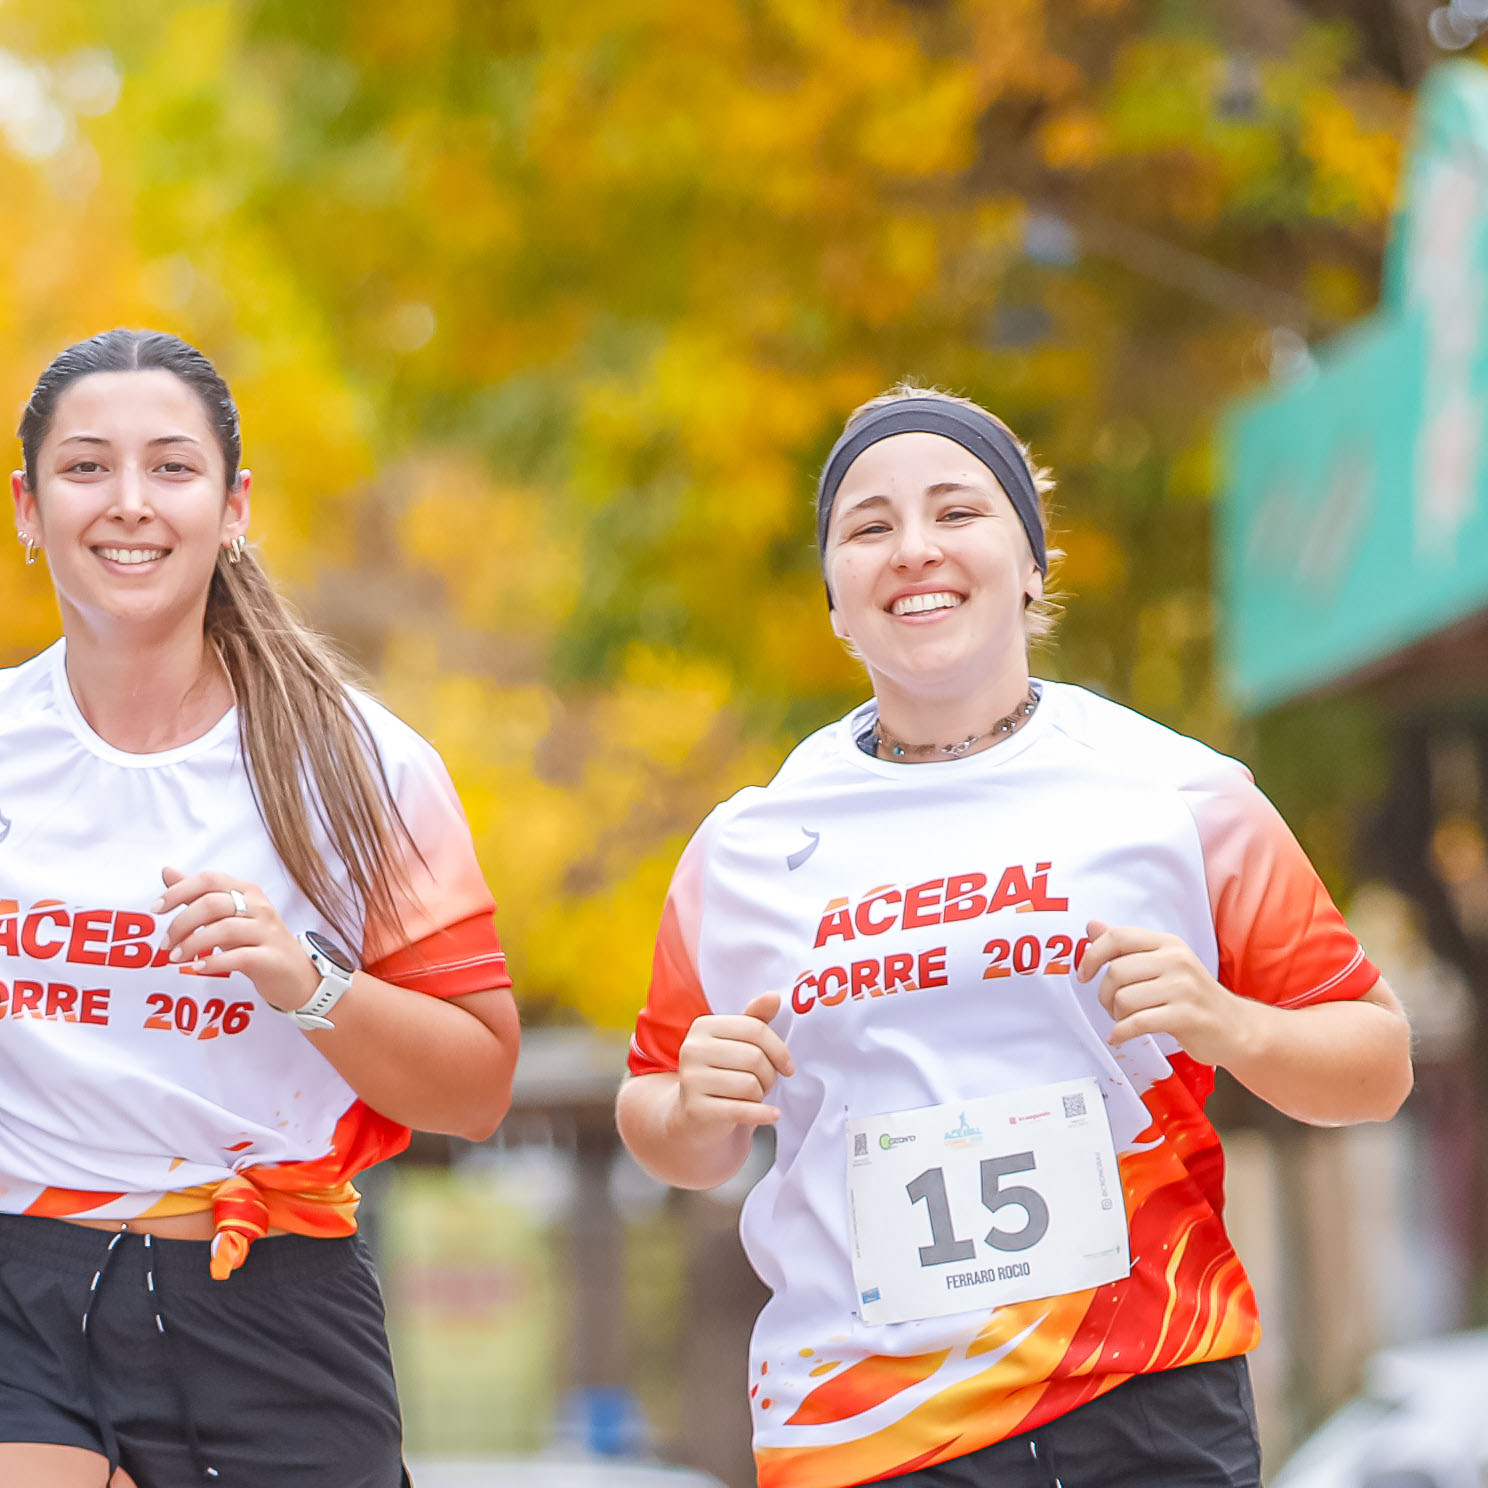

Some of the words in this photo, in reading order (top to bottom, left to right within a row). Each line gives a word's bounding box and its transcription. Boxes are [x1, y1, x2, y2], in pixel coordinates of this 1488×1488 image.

[813, 861, 1069, 949] ACEBAL
[791, 946, 949, 1016] CORRE
[143, 992, 255, 1041] 2026
[905, 1150, 1050, 1268] 15
[945, 1268, 996, 1290] FERRARO
[997, 1262, 1031, 1281] ROCIO
